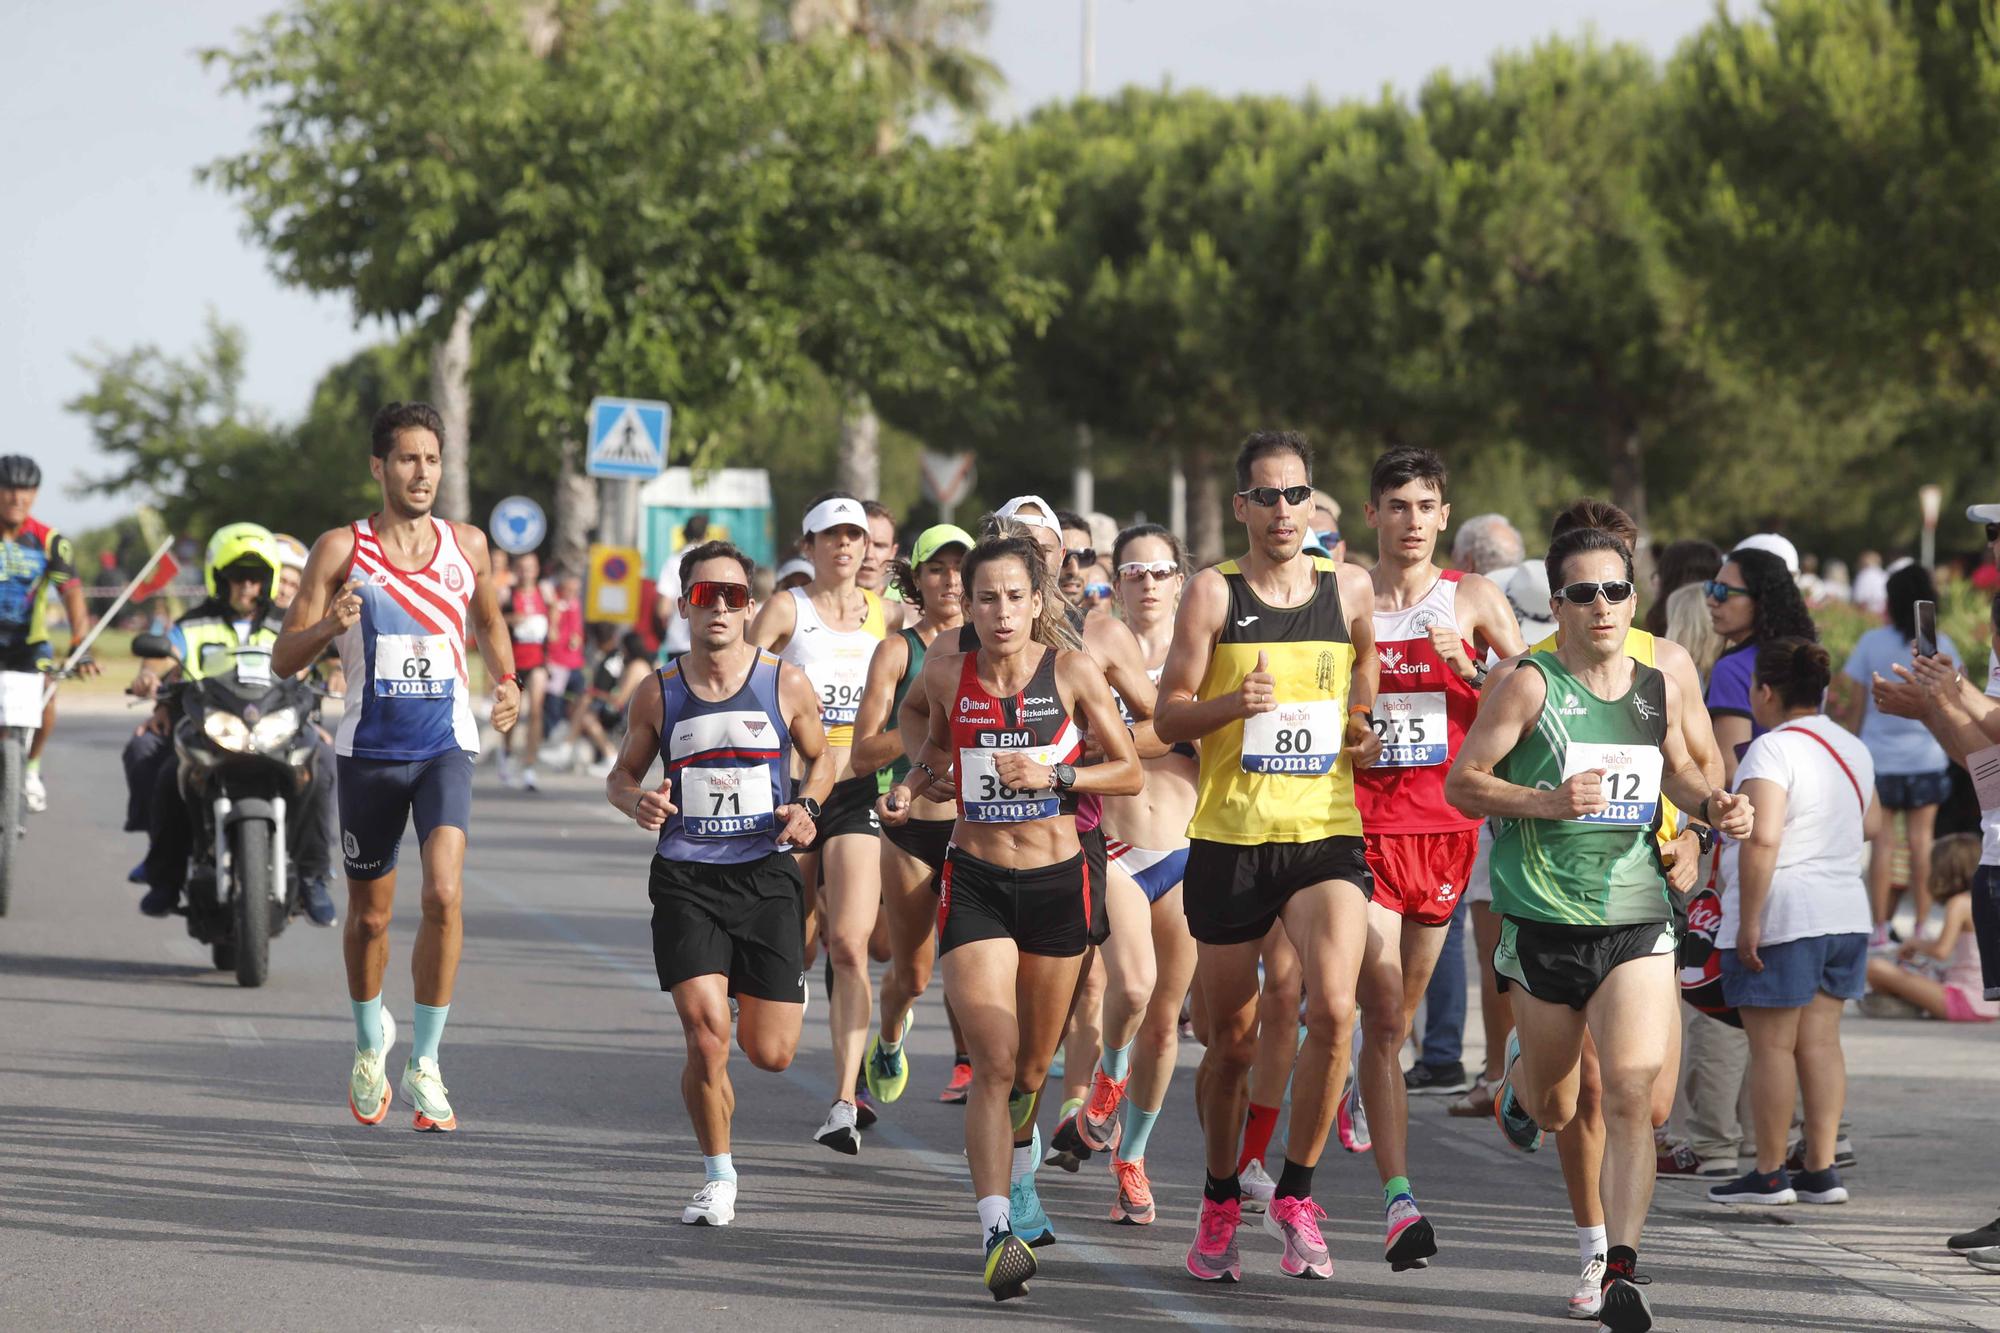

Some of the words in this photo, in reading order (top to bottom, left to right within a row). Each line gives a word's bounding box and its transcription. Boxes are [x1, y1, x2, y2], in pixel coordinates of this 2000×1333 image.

[402, 658, 432, 679] 62
[1400, 662, 1430, 674] Soria
[822, 684, 865, 707] 394
[960, 697, 990, 713] Bilbao
[959, 715, 996, 725] Guedan
[1021, 708, 1059, 718] Bizkaialde
[1000, 732, 1029, 747] BM
[1275, 728, 1312, 754] 80
[1373, 718, 1425, 744] 275
[1599, 773, 1641, 800] 12
[709, 792, 741, 816] 71
